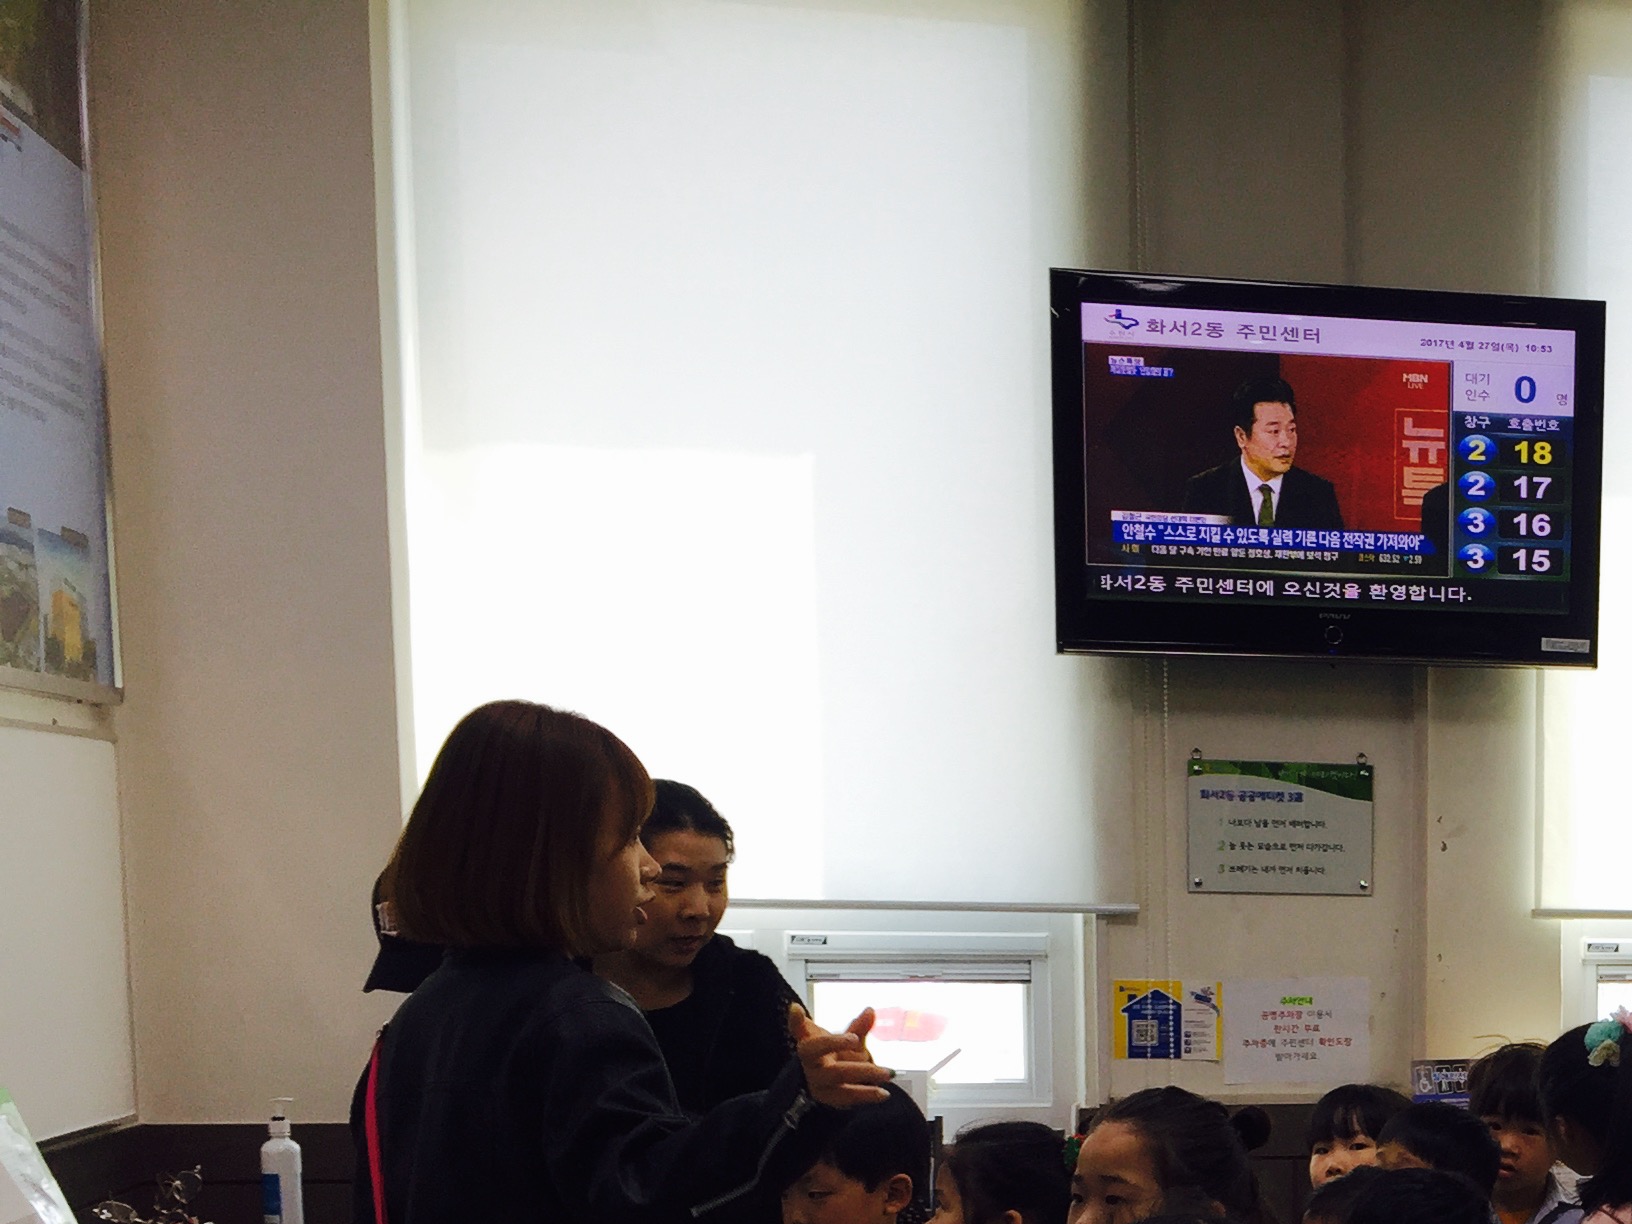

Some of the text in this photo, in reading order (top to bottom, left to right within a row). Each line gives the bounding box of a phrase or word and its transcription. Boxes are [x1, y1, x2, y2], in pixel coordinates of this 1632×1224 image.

[1146, 317, 1321, 344] 화서2동 주민센터
[1420, 339, 1455, 350] 2017년
[1402, 373, 1429, 384] MBN
[1465, 373, 1490, 386] 대기
[1514, 375, 1536, 403] 0
[1465, 389, 1490, 402] 인수
[1556, 393, 1568, 406] 명
[1464, 415, 1561, 432] 창구 호출번호
[1467, 439, 1552, 465] 2 18
[1467, 475, 1552, 499] 2 17
[1122, 523, 1157, 541] 안철수
[1198, 526, 1221, 543] 지킬
[1223, 527, 1235, 544] 수
[1236, 527, 1269, 545] 있도록
[1271, 529, 1293, 546] 실력
[1295, 530, 1318, 547] 기른
[1318, 531, 1341, 548] 다음
[1342, 532, 1375, 549] 전작권
[1467, 512, 1551, 537] 3 16
[1466, 548, 1551, 572] 3 15
[1174, 576, 1274, 596] 주민센터에
[1282, 581, 1361, 599] 오신것을
[1369, 584, 1472, 603] 환영합니다.
[1218, 840, 1225, 851] 2
